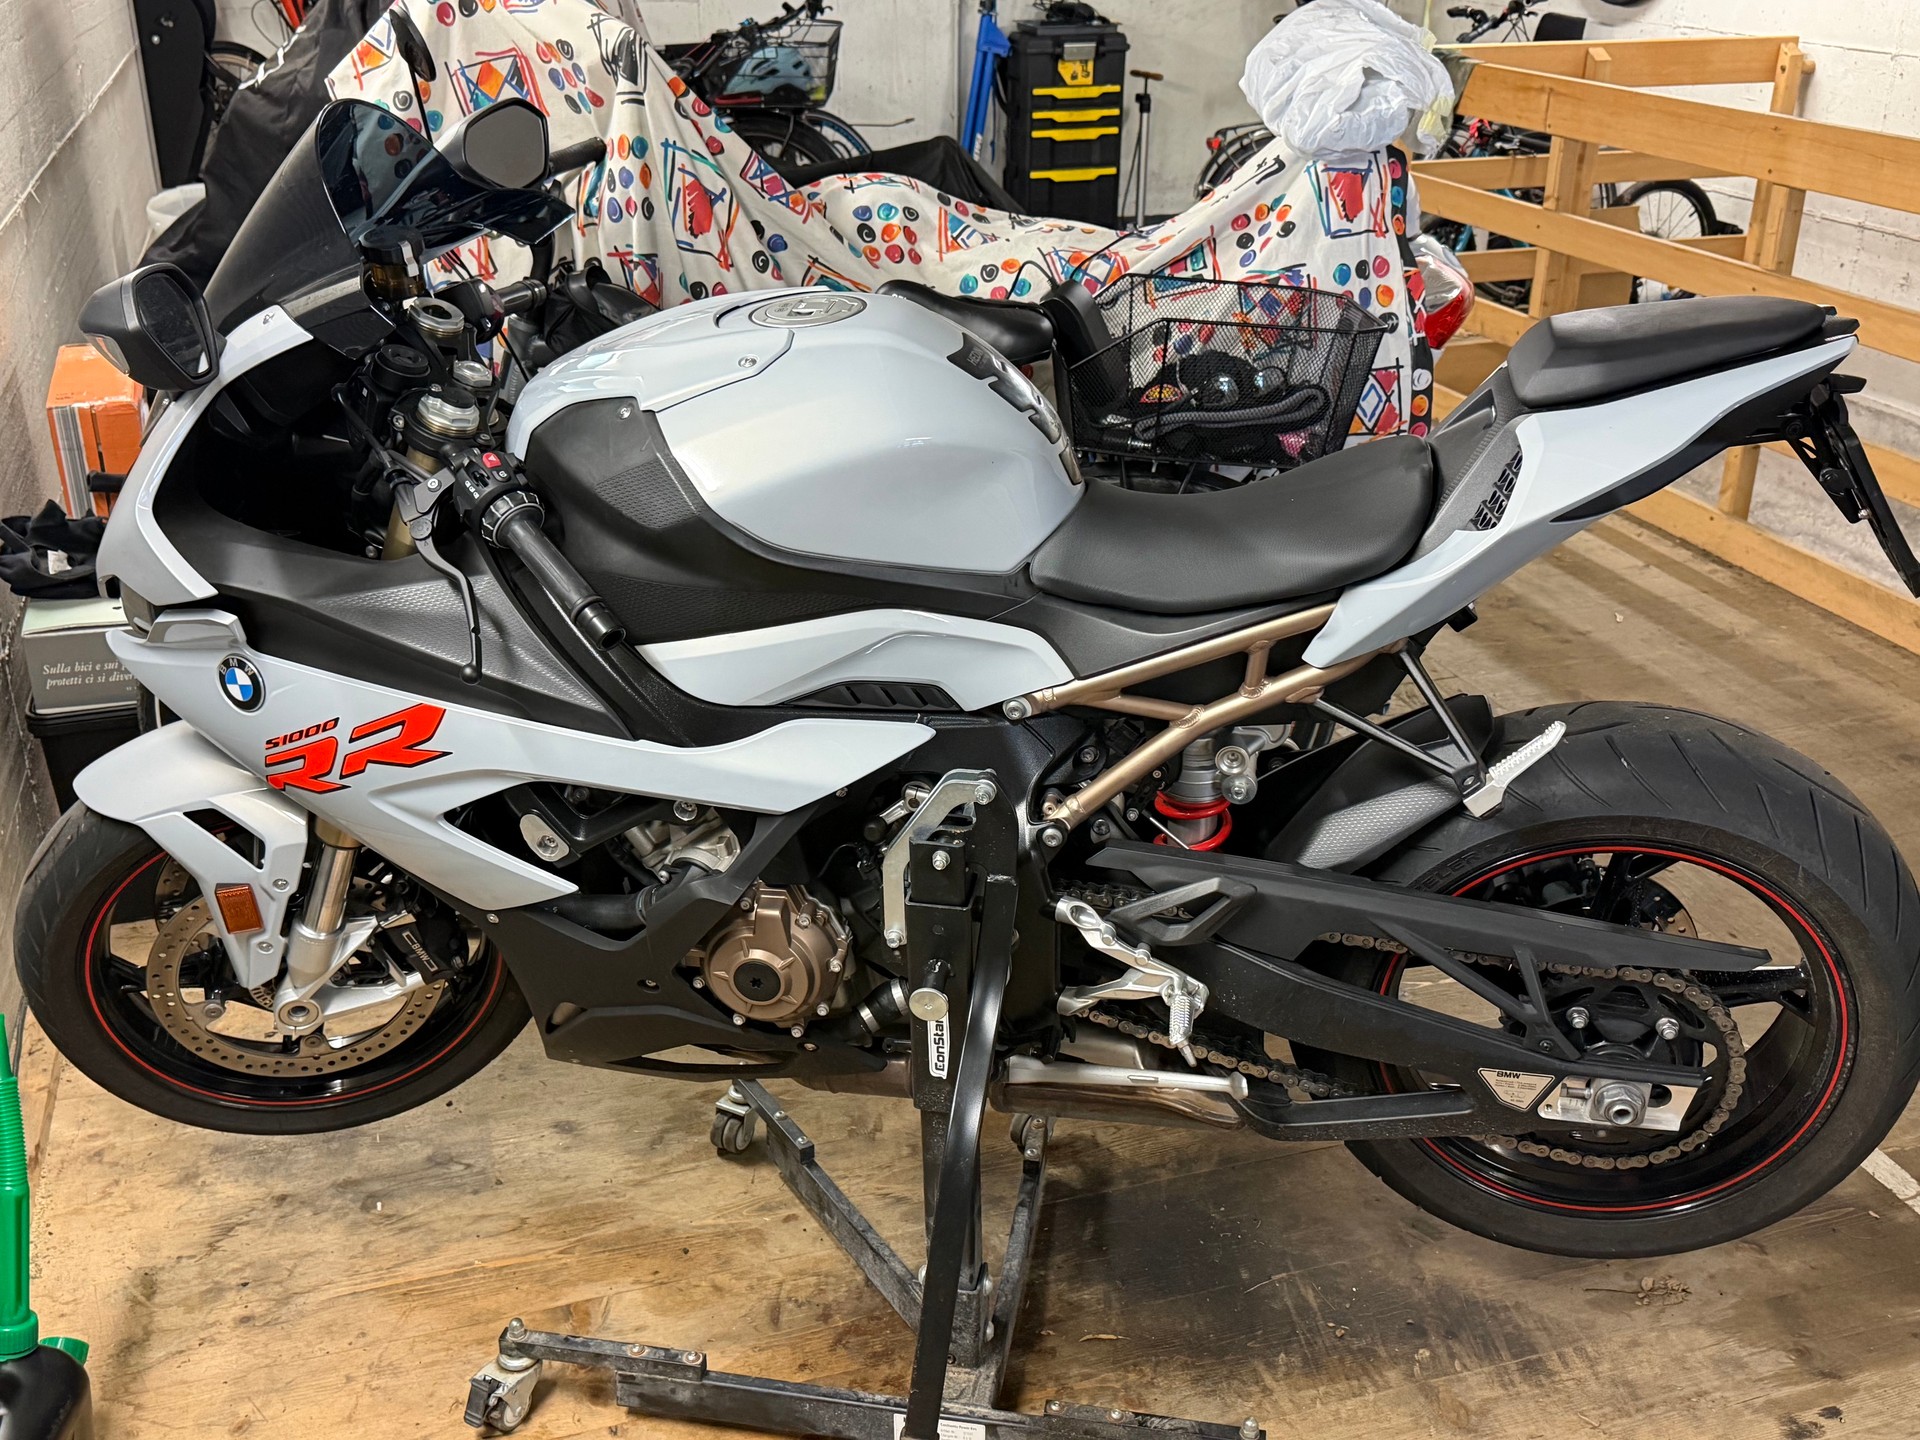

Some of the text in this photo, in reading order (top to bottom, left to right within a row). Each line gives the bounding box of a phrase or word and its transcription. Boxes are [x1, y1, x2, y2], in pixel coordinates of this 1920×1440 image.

[42, 662, 71, 675] Sulla
[75, 661, 92, 672] bici
[95, 663, 101, 671] e
[104, 660, 119, 670] sui
[219, 657, 255, 677] BMW
[46, 674, 82, 690] protetti
[85, 673, 94, 684] ci
[97, 672, 105, 683] si
[264, 716, 340, 750] S1000
[264, 702, 454, 795] RR
[411, 942, 431, 962] BMW
[934, 1019, 946, 1072] ConSta
[1496, 1070, 1521, 1079] BMW
